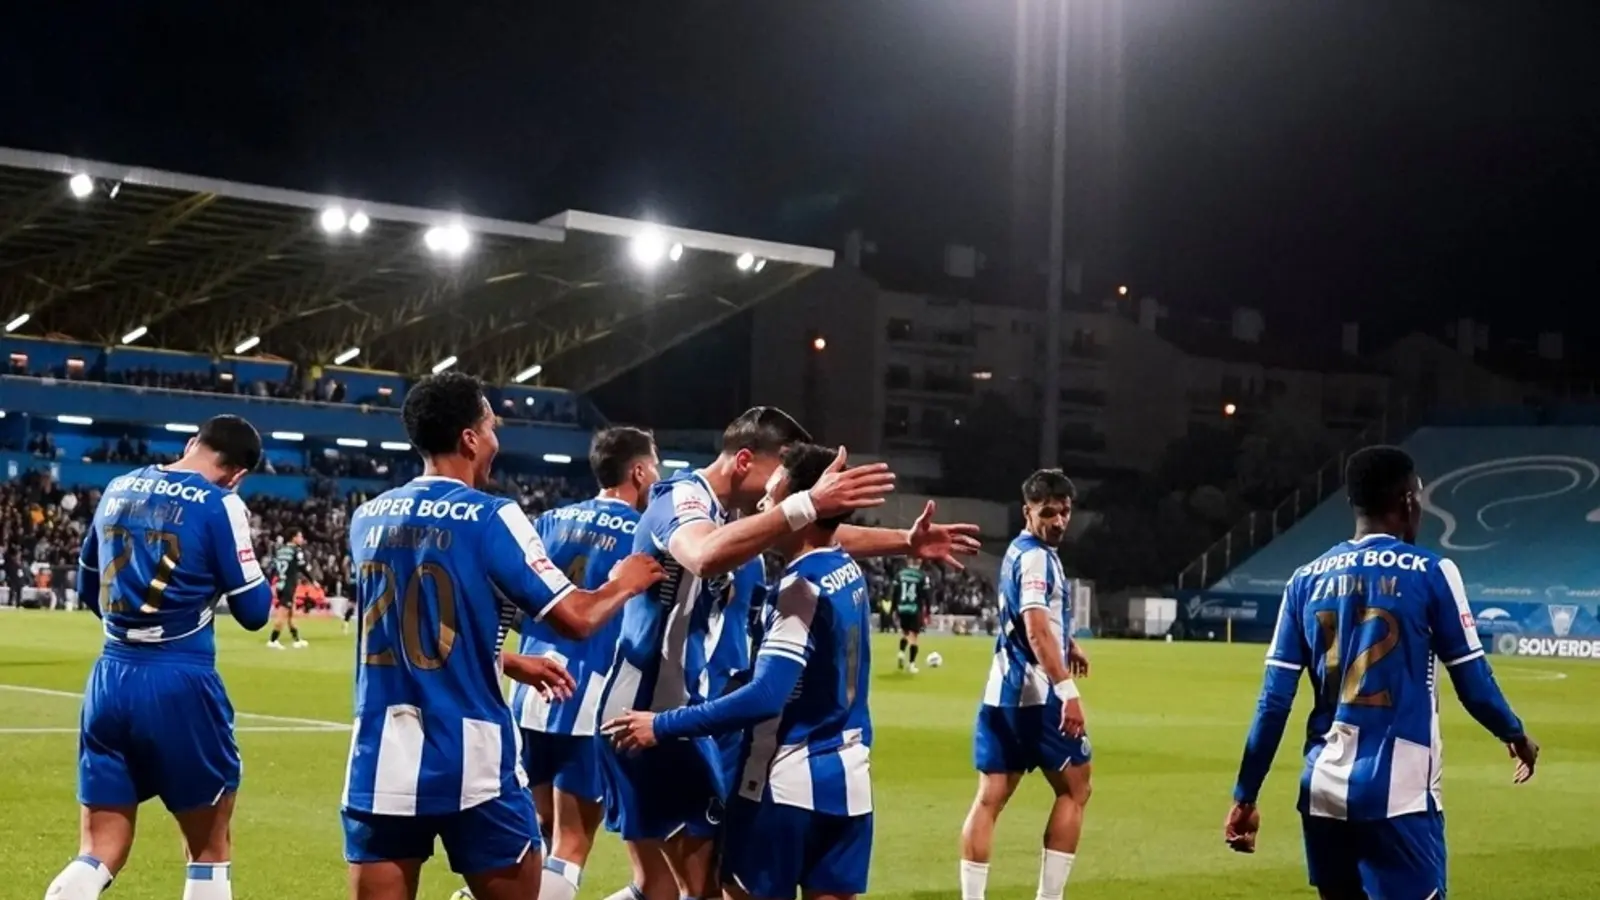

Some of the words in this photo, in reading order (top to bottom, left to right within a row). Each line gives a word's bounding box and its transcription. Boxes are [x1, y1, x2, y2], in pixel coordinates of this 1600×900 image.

[110, 477, 151, 494] SUPER
[154, 480, 211, 504] BOCK
[359, 498, 414, 518] SUPER
[417, 500, 484, 521] BOCK
[554, 507, 596, 524] SUPER
[597, 512, 637, 535] BOC
[102, 524, 181, 614] 27
[1300, 551, 1359, 577] SUPER
[1362, 550, 1430, 573] BOCK
[820, 562, 858, 595] SUPER
[900, 581, 917, 601] 14
[360, 560, 458, 671] 20
[1315, 607, 1400, 707] 12
[1519, 638, 1600, 657] SOLVERDE
